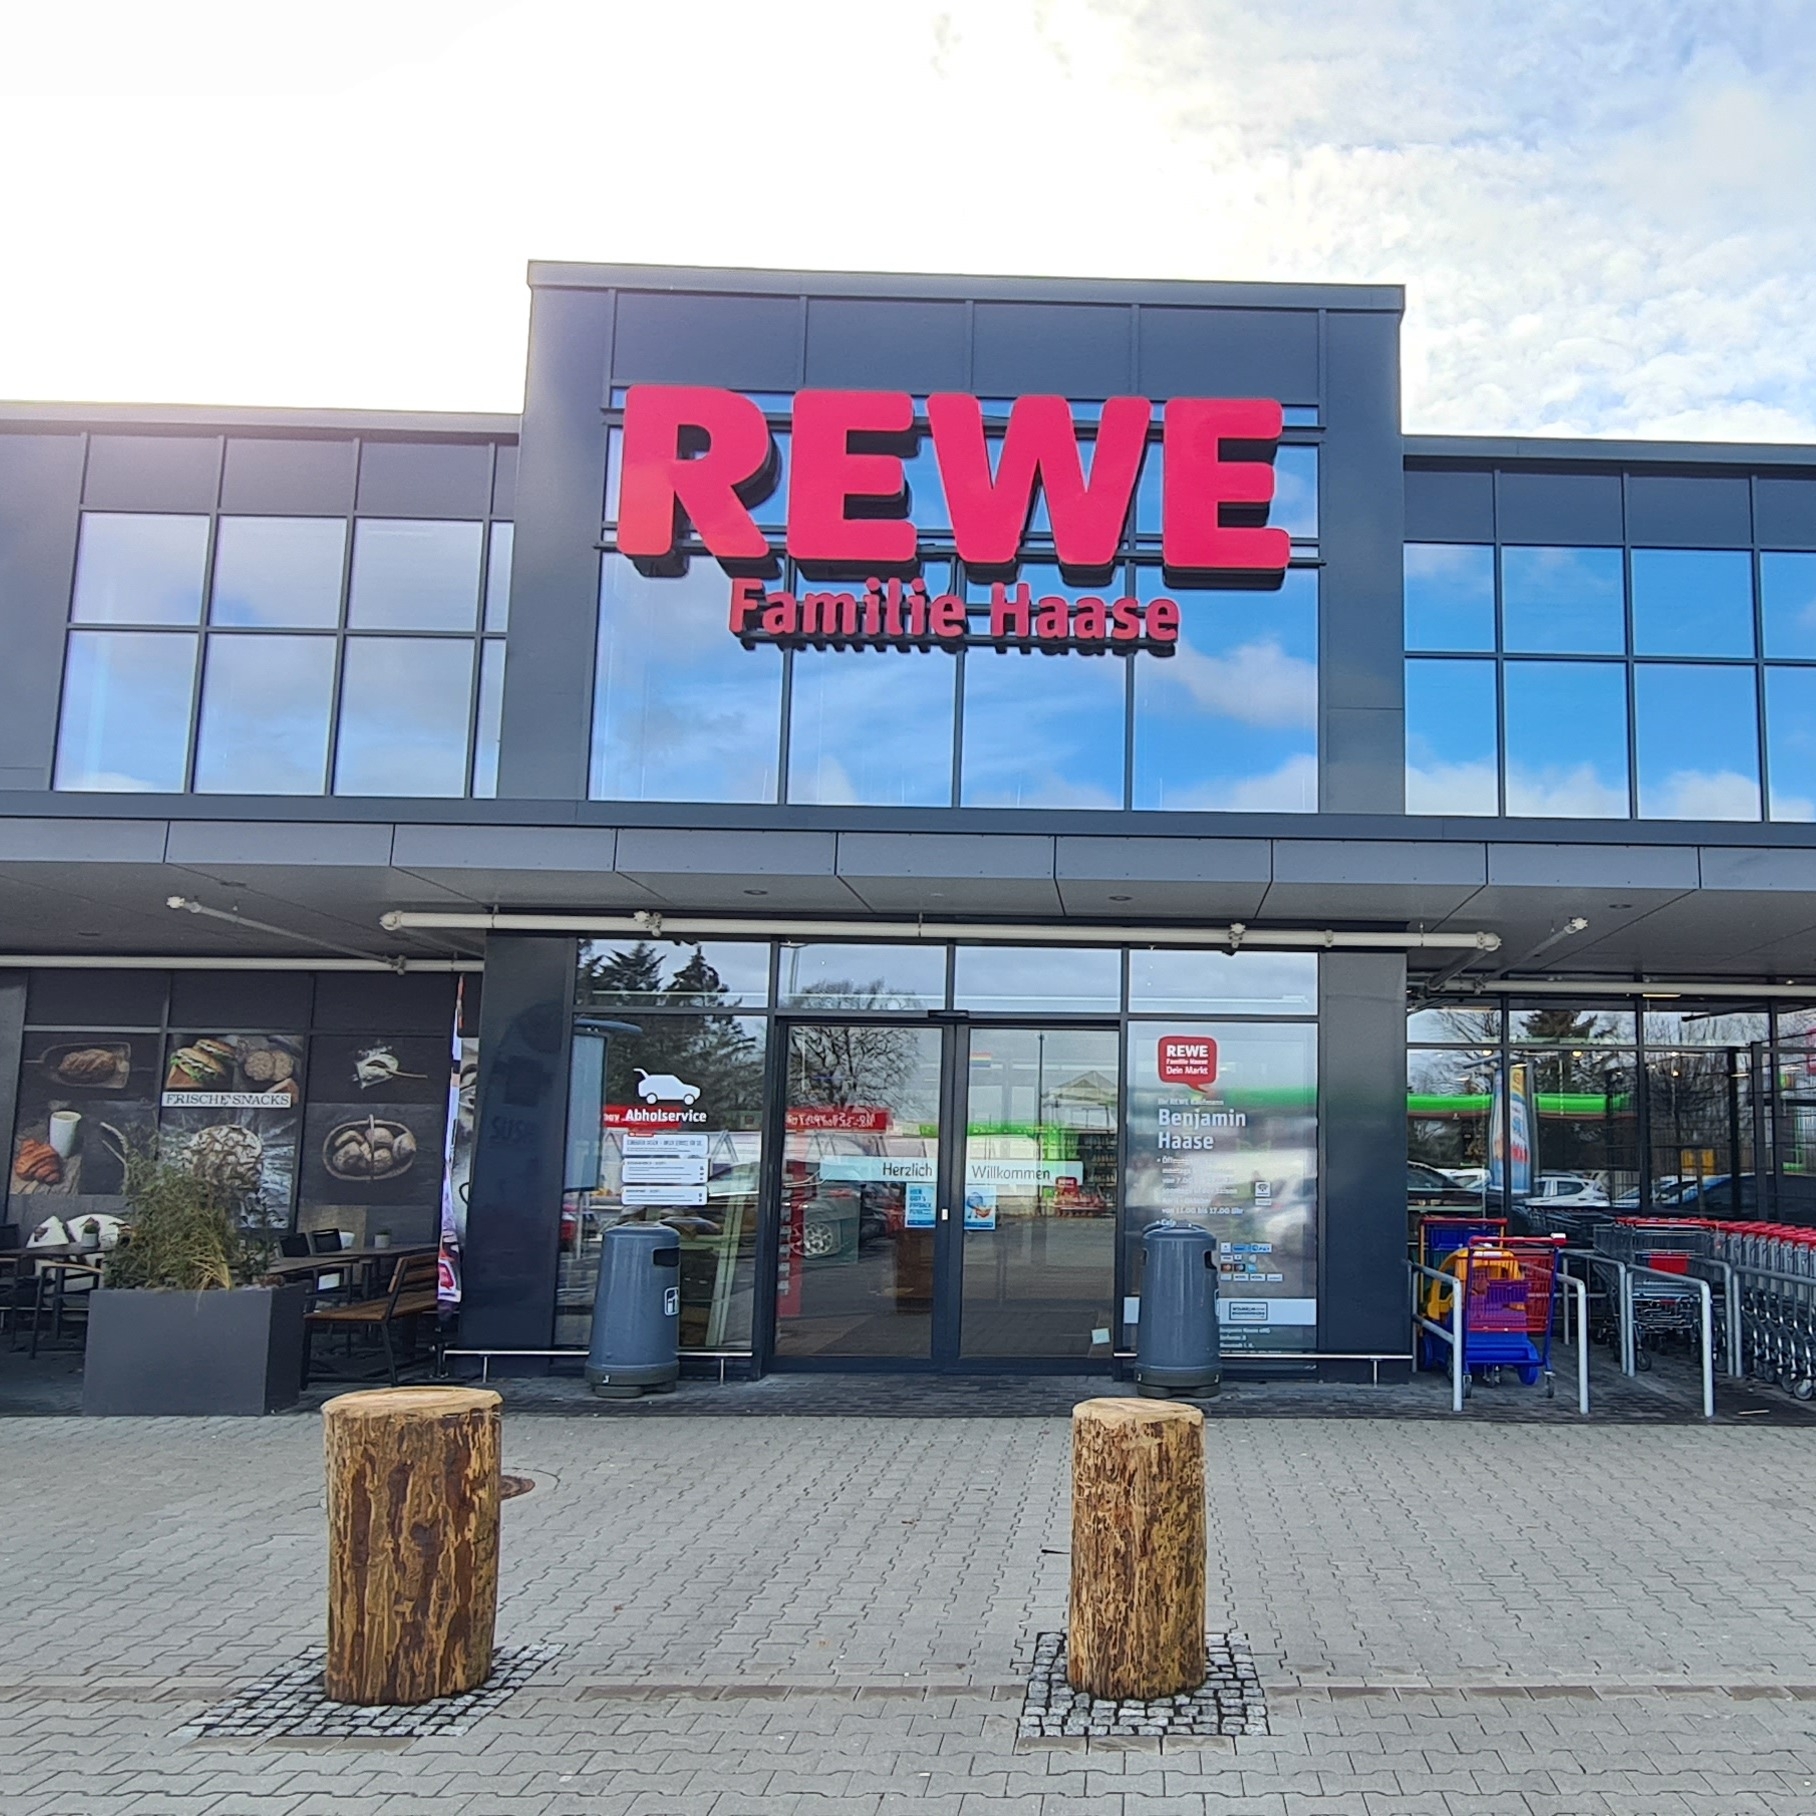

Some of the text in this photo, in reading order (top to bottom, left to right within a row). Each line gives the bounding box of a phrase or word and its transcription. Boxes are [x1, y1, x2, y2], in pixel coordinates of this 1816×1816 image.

[616, 384, 1290, 568] REWE
[729, 576, 1180, 641] Familie Haase
[1166, 1045, 1208, 1057] REWE
[1166, 1066, 1208, 1075] Dein Markt
[166, 1094, 289, 1105] FRISCHE SNACKS
[625, 1108, 707, 1122] Abholservice
[1158, 1108, 1246, 1130] Benjamin
[1158, 1131, 1214, 1149] Haase
[882, 1162, 1050, 1180] Herzlich Willkommen
